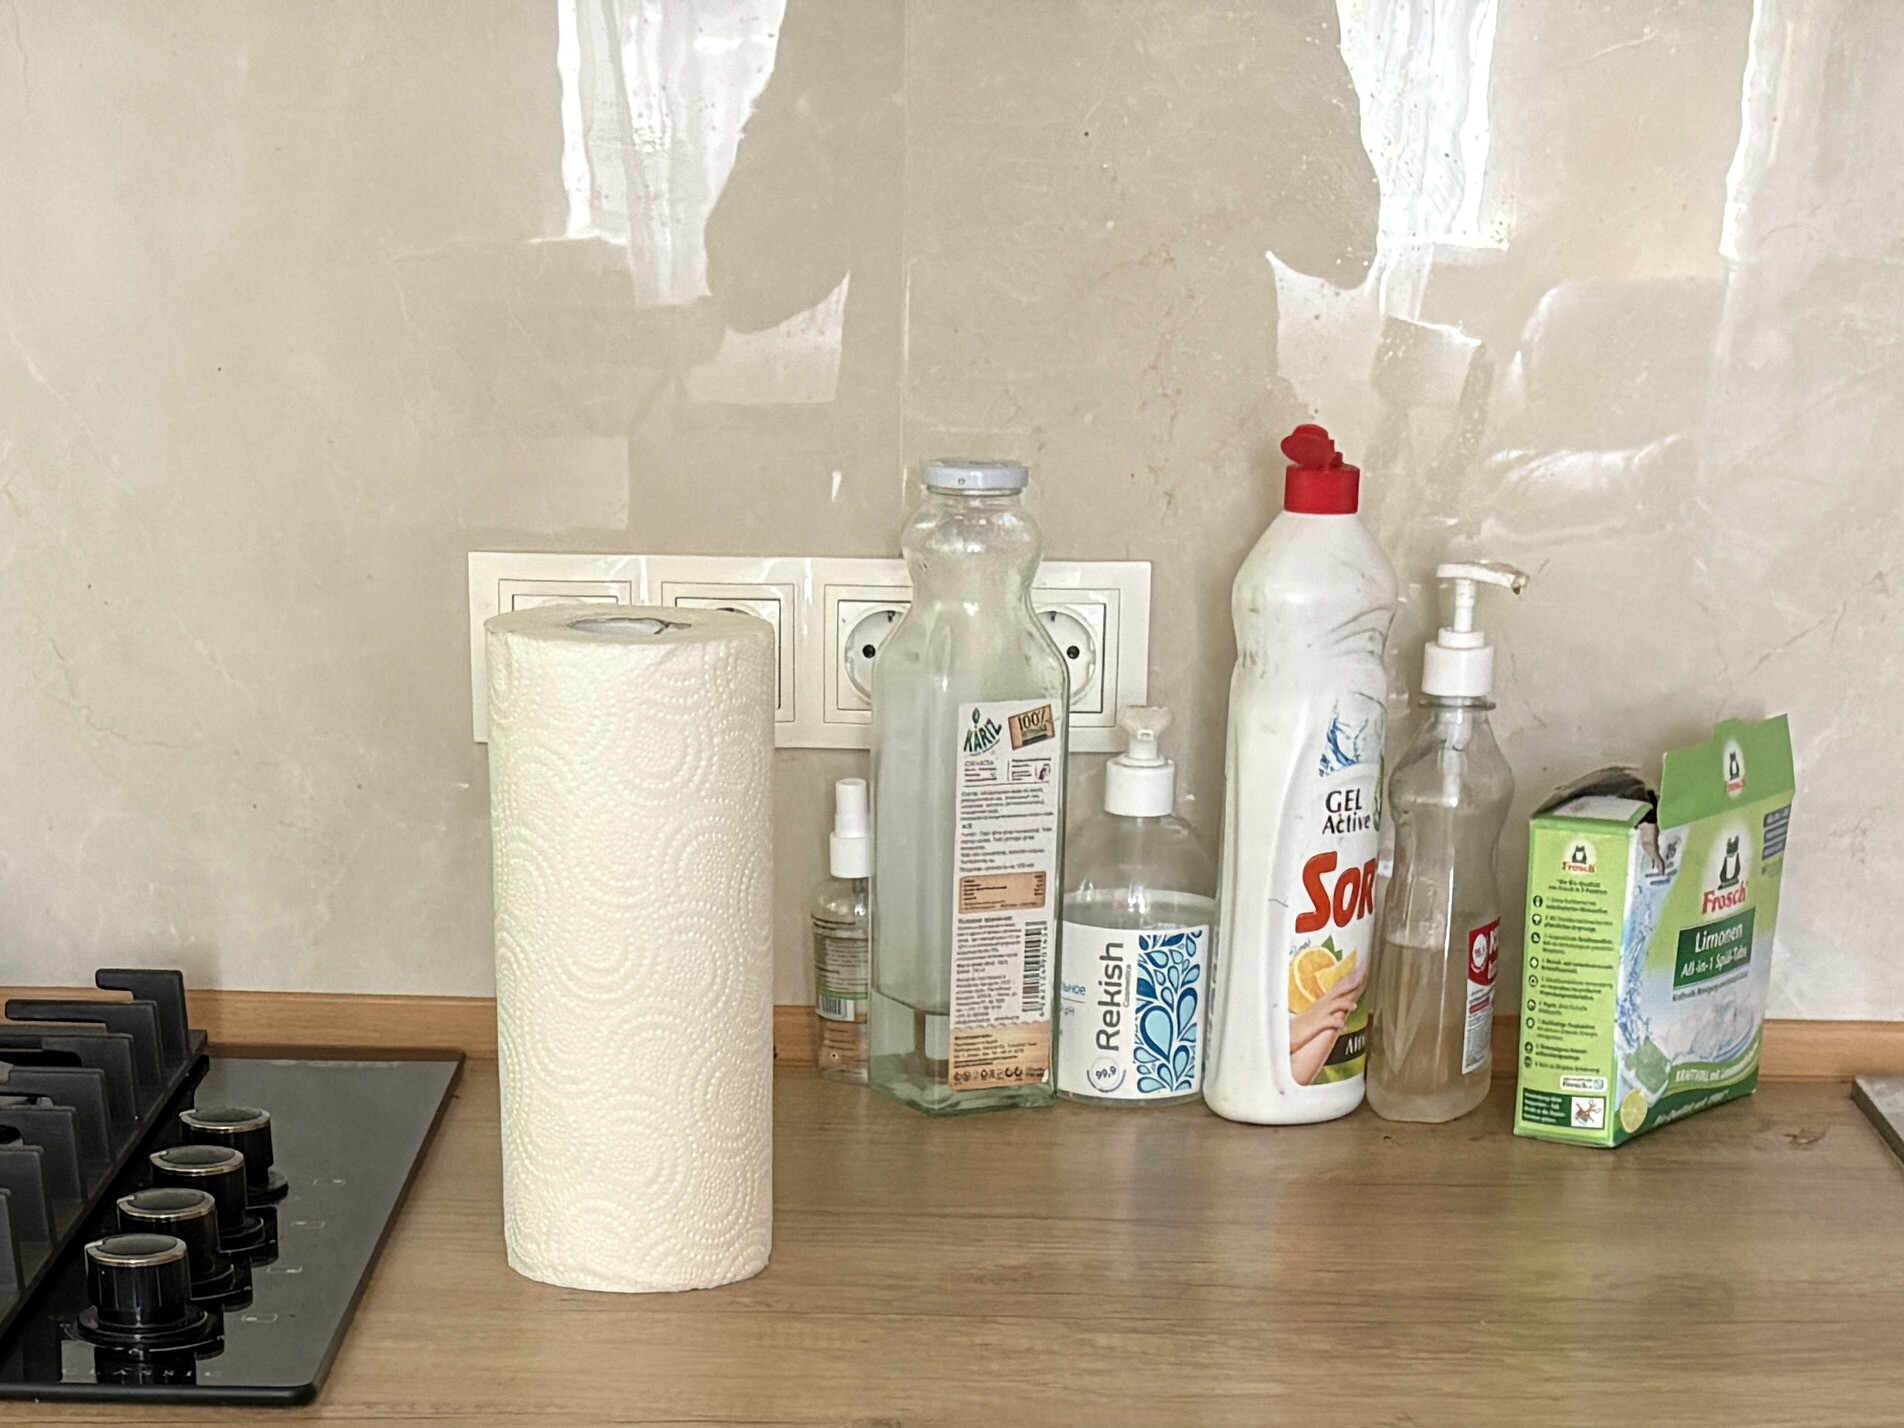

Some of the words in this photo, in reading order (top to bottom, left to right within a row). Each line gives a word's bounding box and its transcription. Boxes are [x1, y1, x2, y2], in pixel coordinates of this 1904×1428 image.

[1325, 788, 1362, 813] GEL
[1322, 811, 1371, 835] Active
[1701, 881, 1747, 915] Frosch
[1694, 923, 1743, 953] Limonen
[1096, 942, 1124, 1051] Rekish
